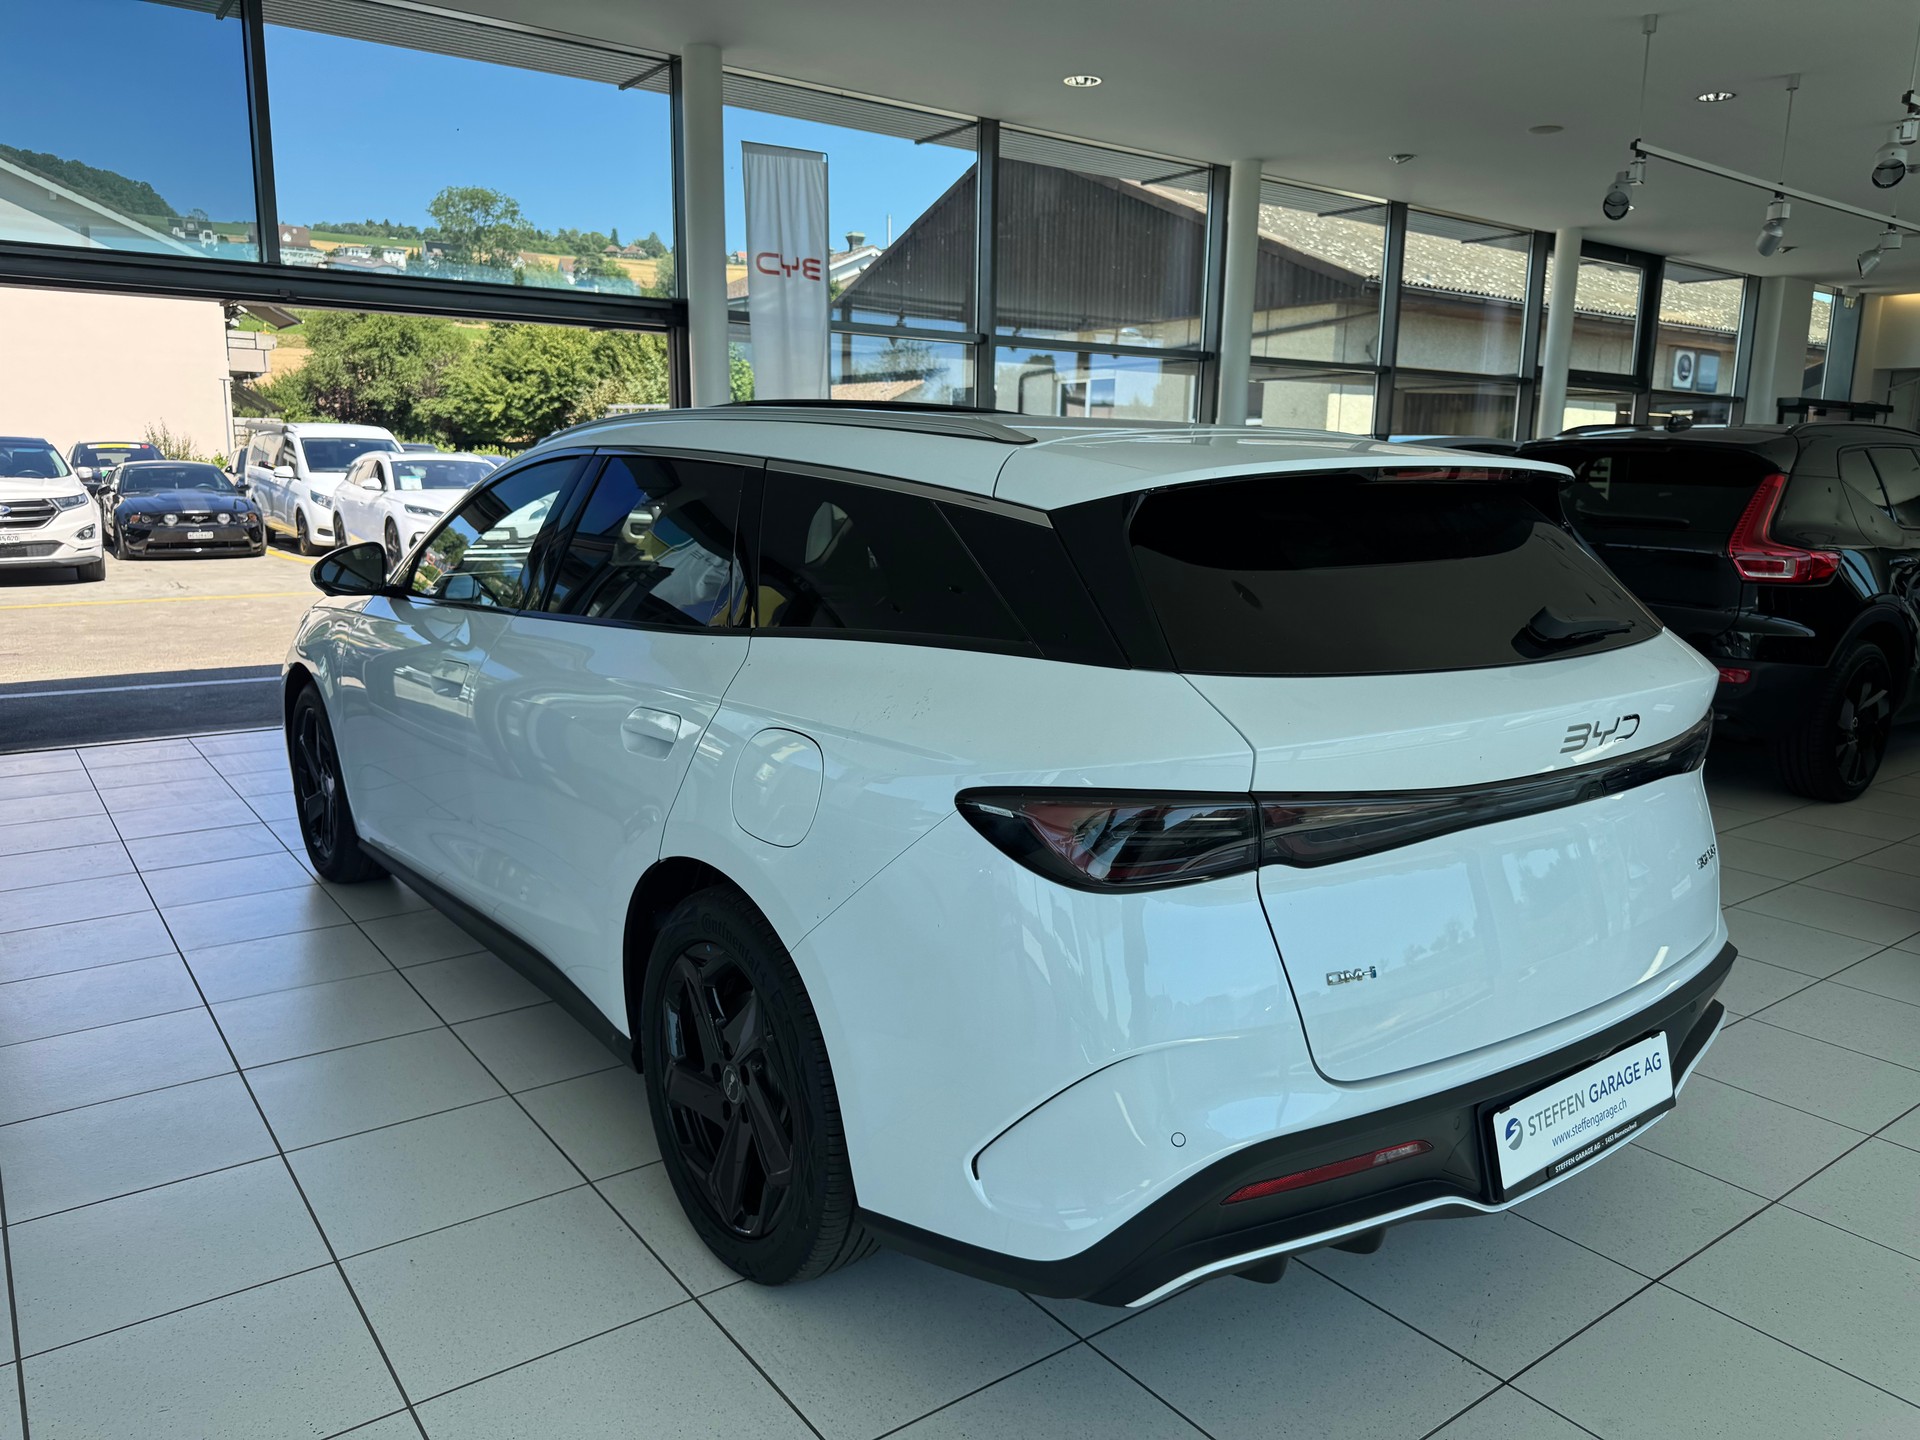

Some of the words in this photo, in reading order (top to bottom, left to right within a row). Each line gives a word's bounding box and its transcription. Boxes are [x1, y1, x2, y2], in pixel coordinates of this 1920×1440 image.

[1559, 713, 1641, 754] BYD
[702, 913, 760, 974] Continental
[1326, 966, 1377, 986] DM-i
[1527, 1089, 1586, 1137] STEFFEN
[1588, 1061, 1642, 1103] GARAGE
[1644, 1051, 1663, 1077] AG
[1551, 1097, 1628, 1147] www.steffengarage.ch
[1554, 1156, 1576, 1173] STEFFEN
[1575, 1146, 1594, 1161] GARAGE
[1593, 1141, 1601, 1151] AG
